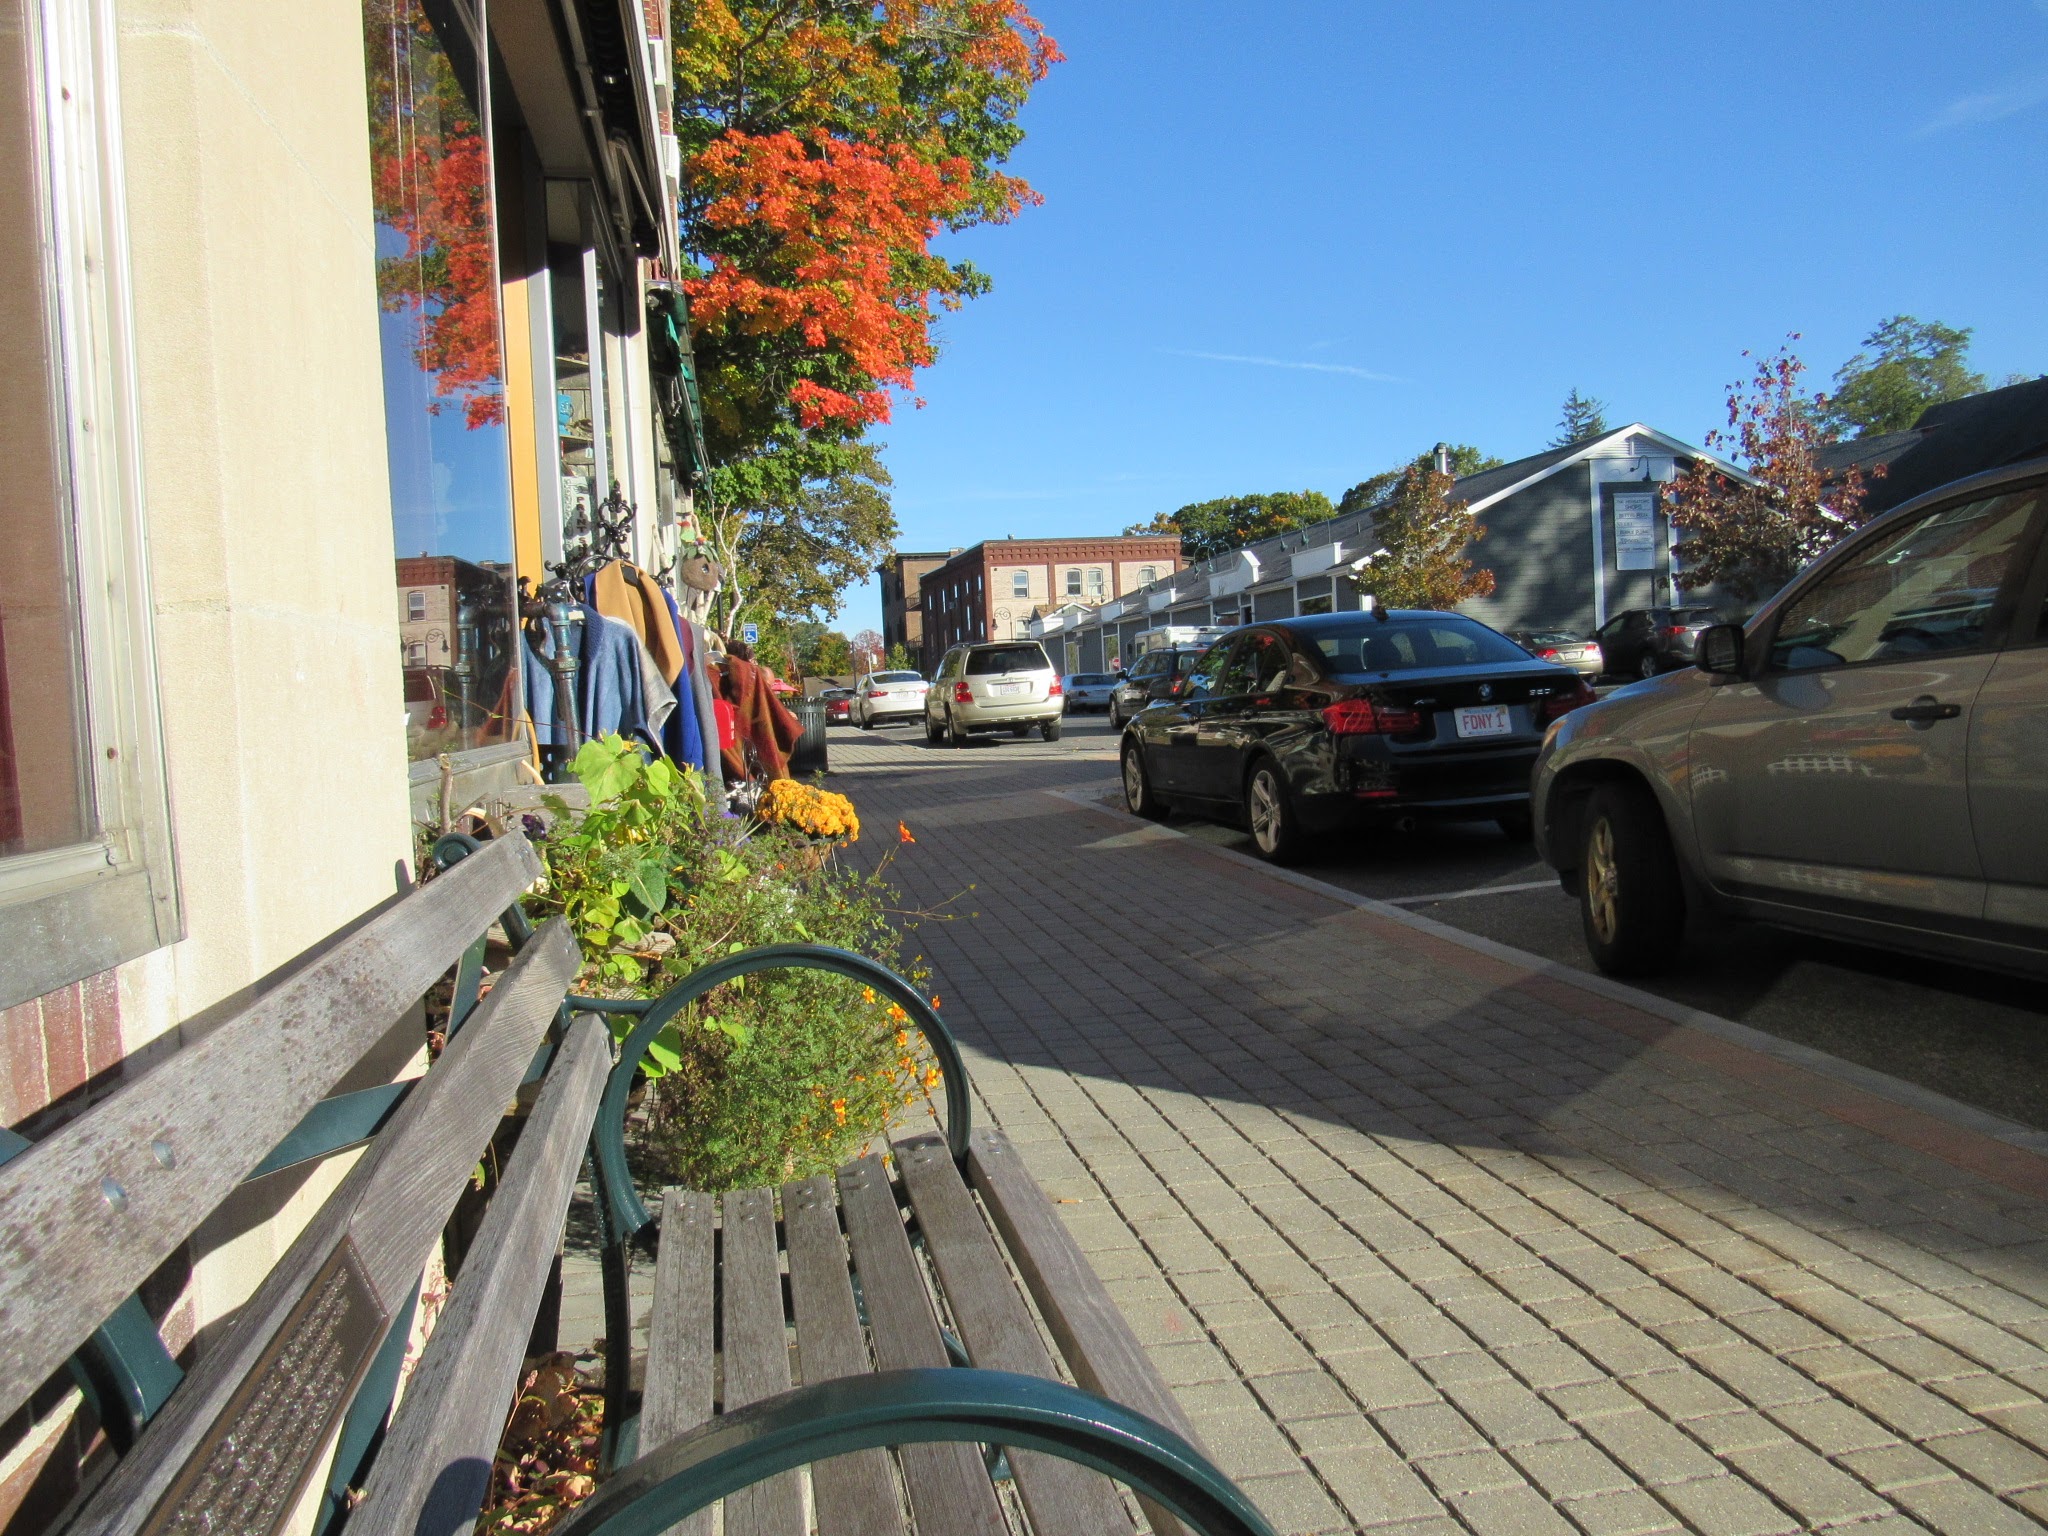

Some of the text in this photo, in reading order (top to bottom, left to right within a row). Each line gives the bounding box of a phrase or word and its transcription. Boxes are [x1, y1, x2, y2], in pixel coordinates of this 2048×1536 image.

[576, 496, 587, 533] PRINT
[1462, 713, 1505, 730] FDNY 1
